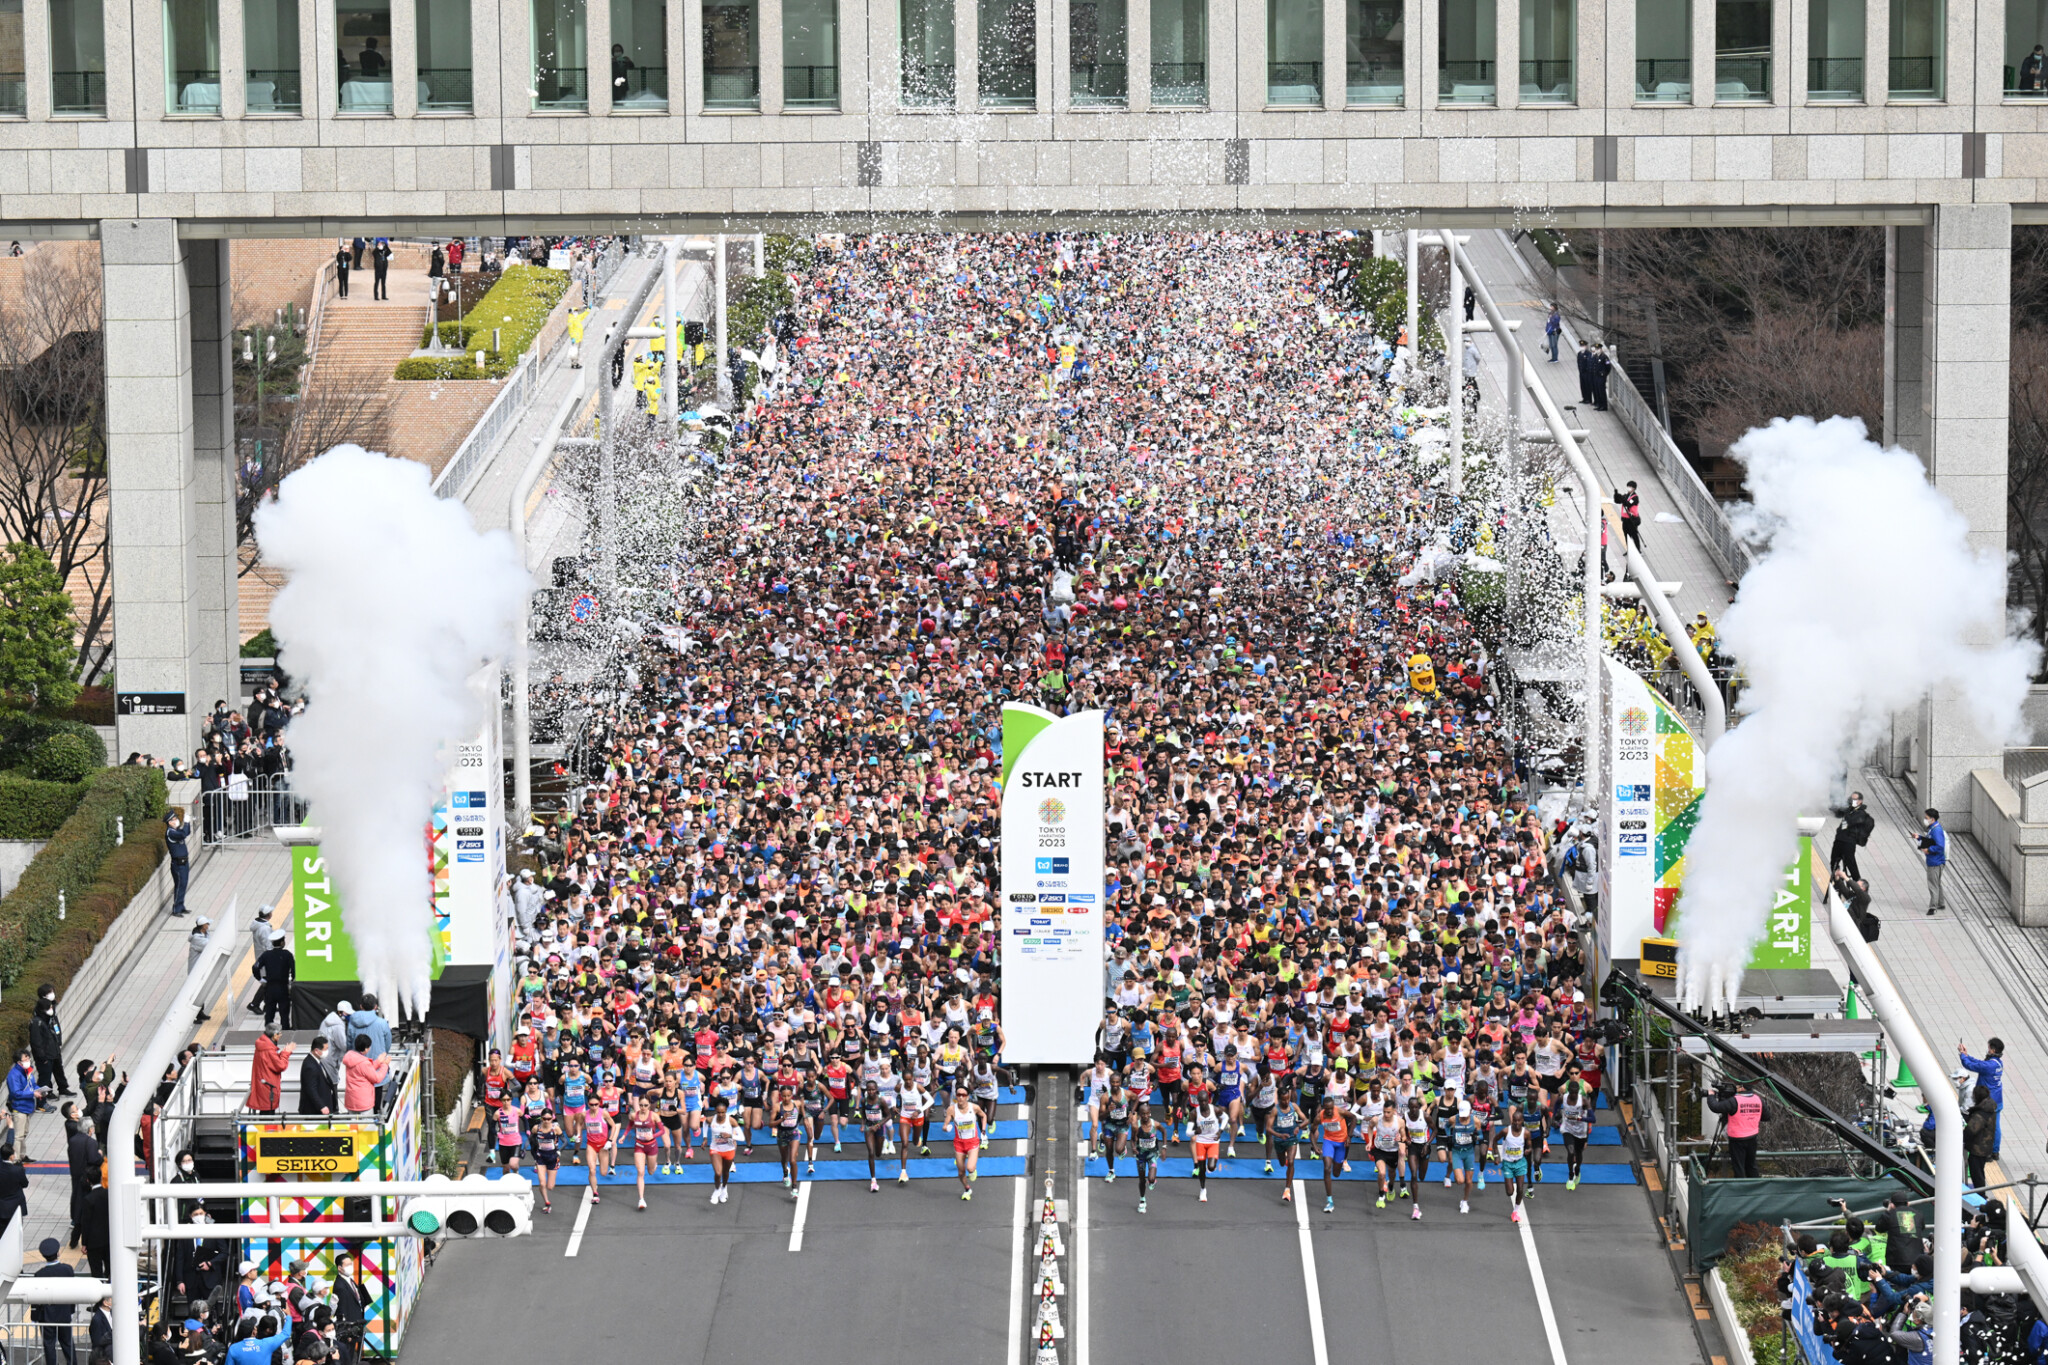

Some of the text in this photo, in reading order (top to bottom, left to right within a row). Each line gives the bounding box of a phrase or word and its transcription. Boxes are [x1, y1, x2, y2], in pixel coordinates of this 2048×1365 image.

[1619, 751, 1648, 760] 2023
[1022, 772, 1083, 788] START
[1039, 839, 1066, 847] 2023
[303, 857, 333, 962] START
[1772, 852, 1800, 953] TART
[276, 1159, 338, 1172] SEIKO
